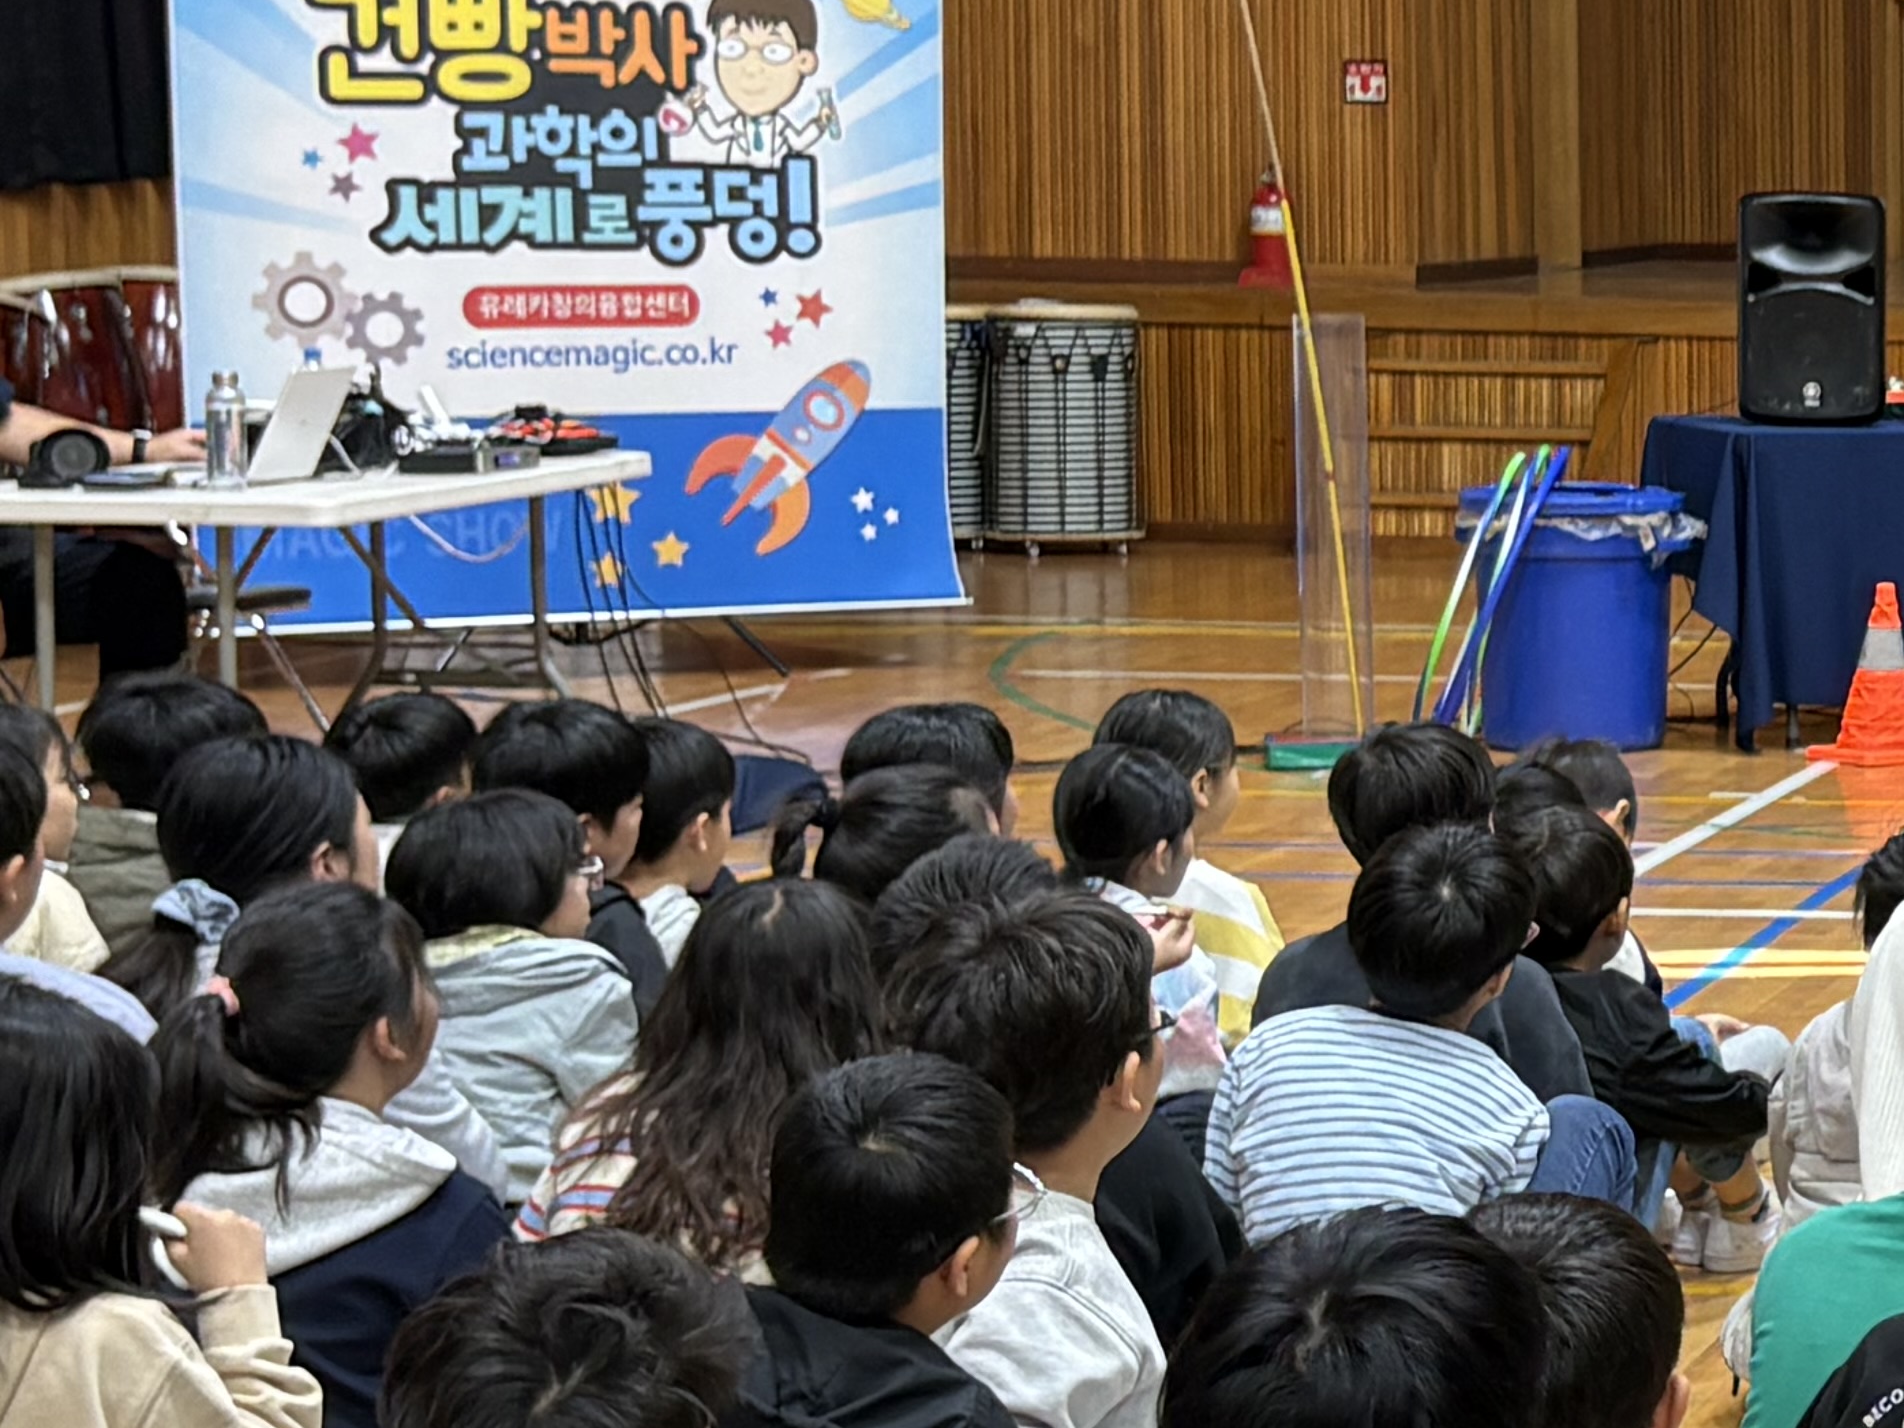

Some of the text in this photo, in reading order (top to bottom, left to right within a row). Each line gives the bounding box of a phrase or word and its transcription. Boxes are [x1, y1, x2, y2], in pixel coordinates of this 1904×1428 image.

[460, 107, 660, 190] 과학의
[378, 159, 822, 264] 세계로 풍덩!
[479, 289, 691, 320] 유레카창의융합센터
[447, 336, 738, 374] sciencemagic.co.kr
